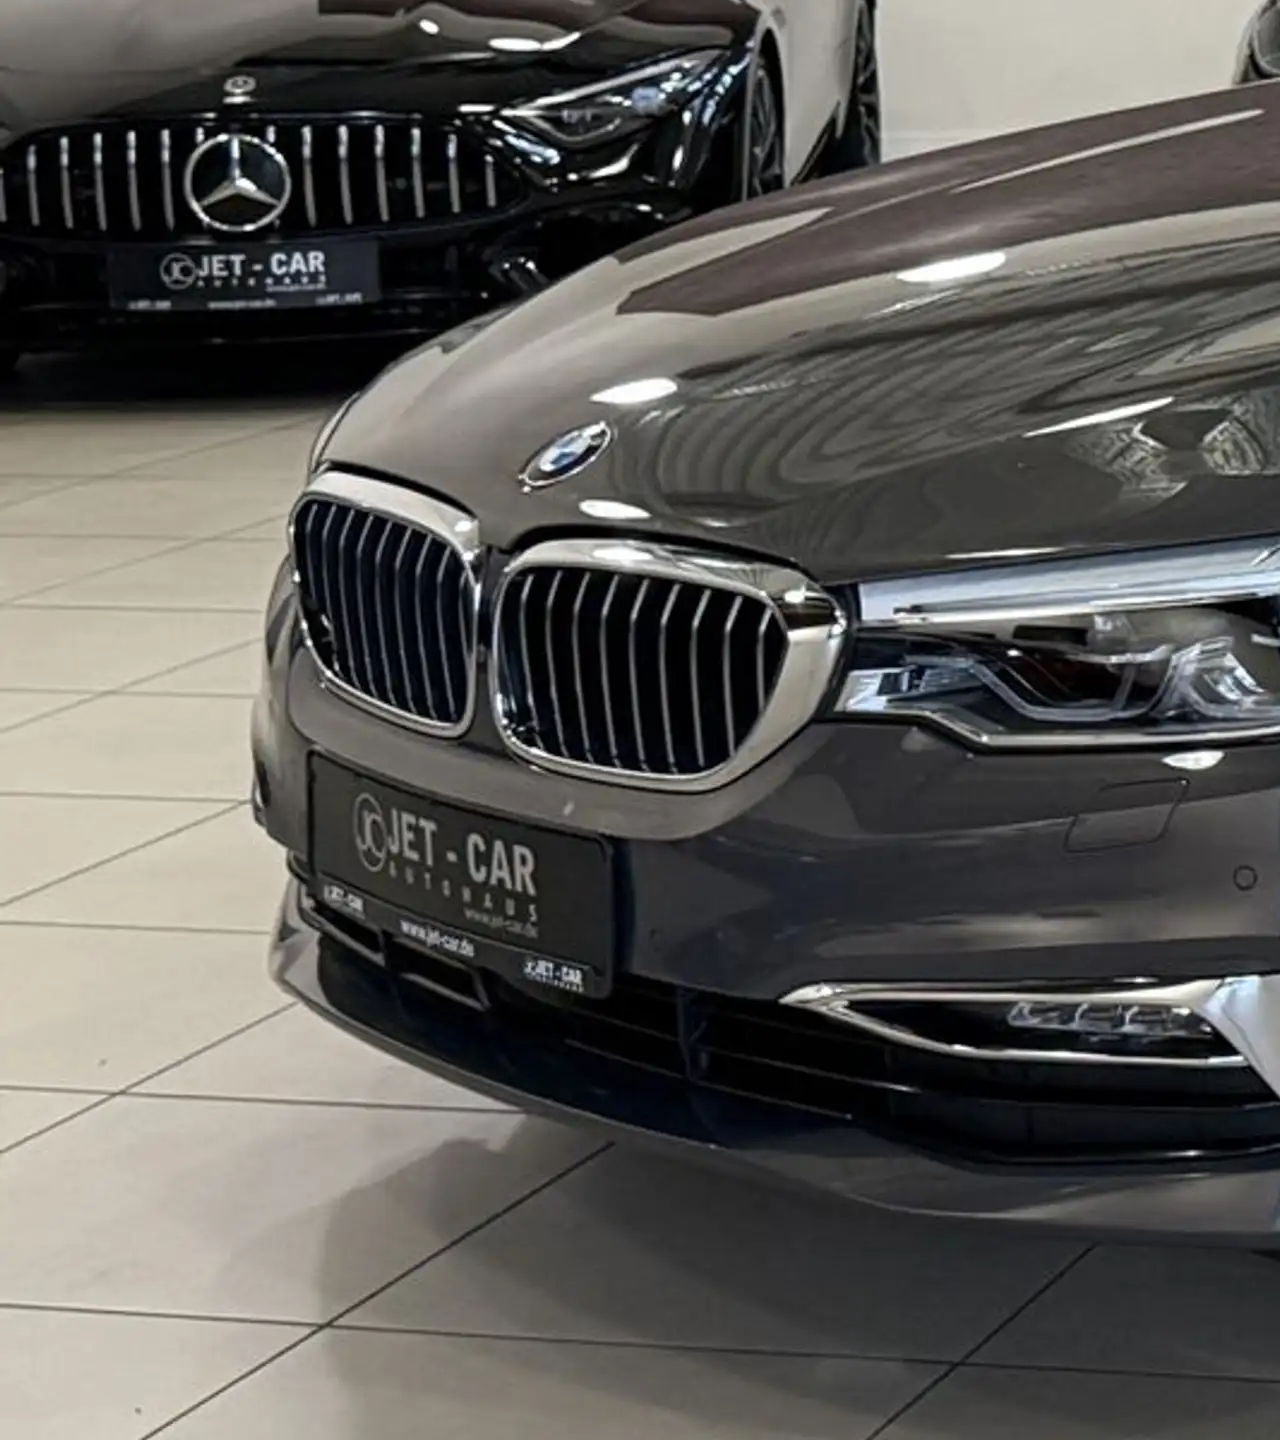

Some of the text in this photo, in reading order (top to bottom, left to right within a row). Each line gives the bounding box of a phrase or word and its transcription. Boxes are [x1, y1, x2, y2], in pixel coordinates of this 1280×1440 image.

[197, 254, 246, 277] JET
[270, 250, 325, 275] CAR
[387, 807, 437, 867] JET
[466, 832, 537, 897] CAR
